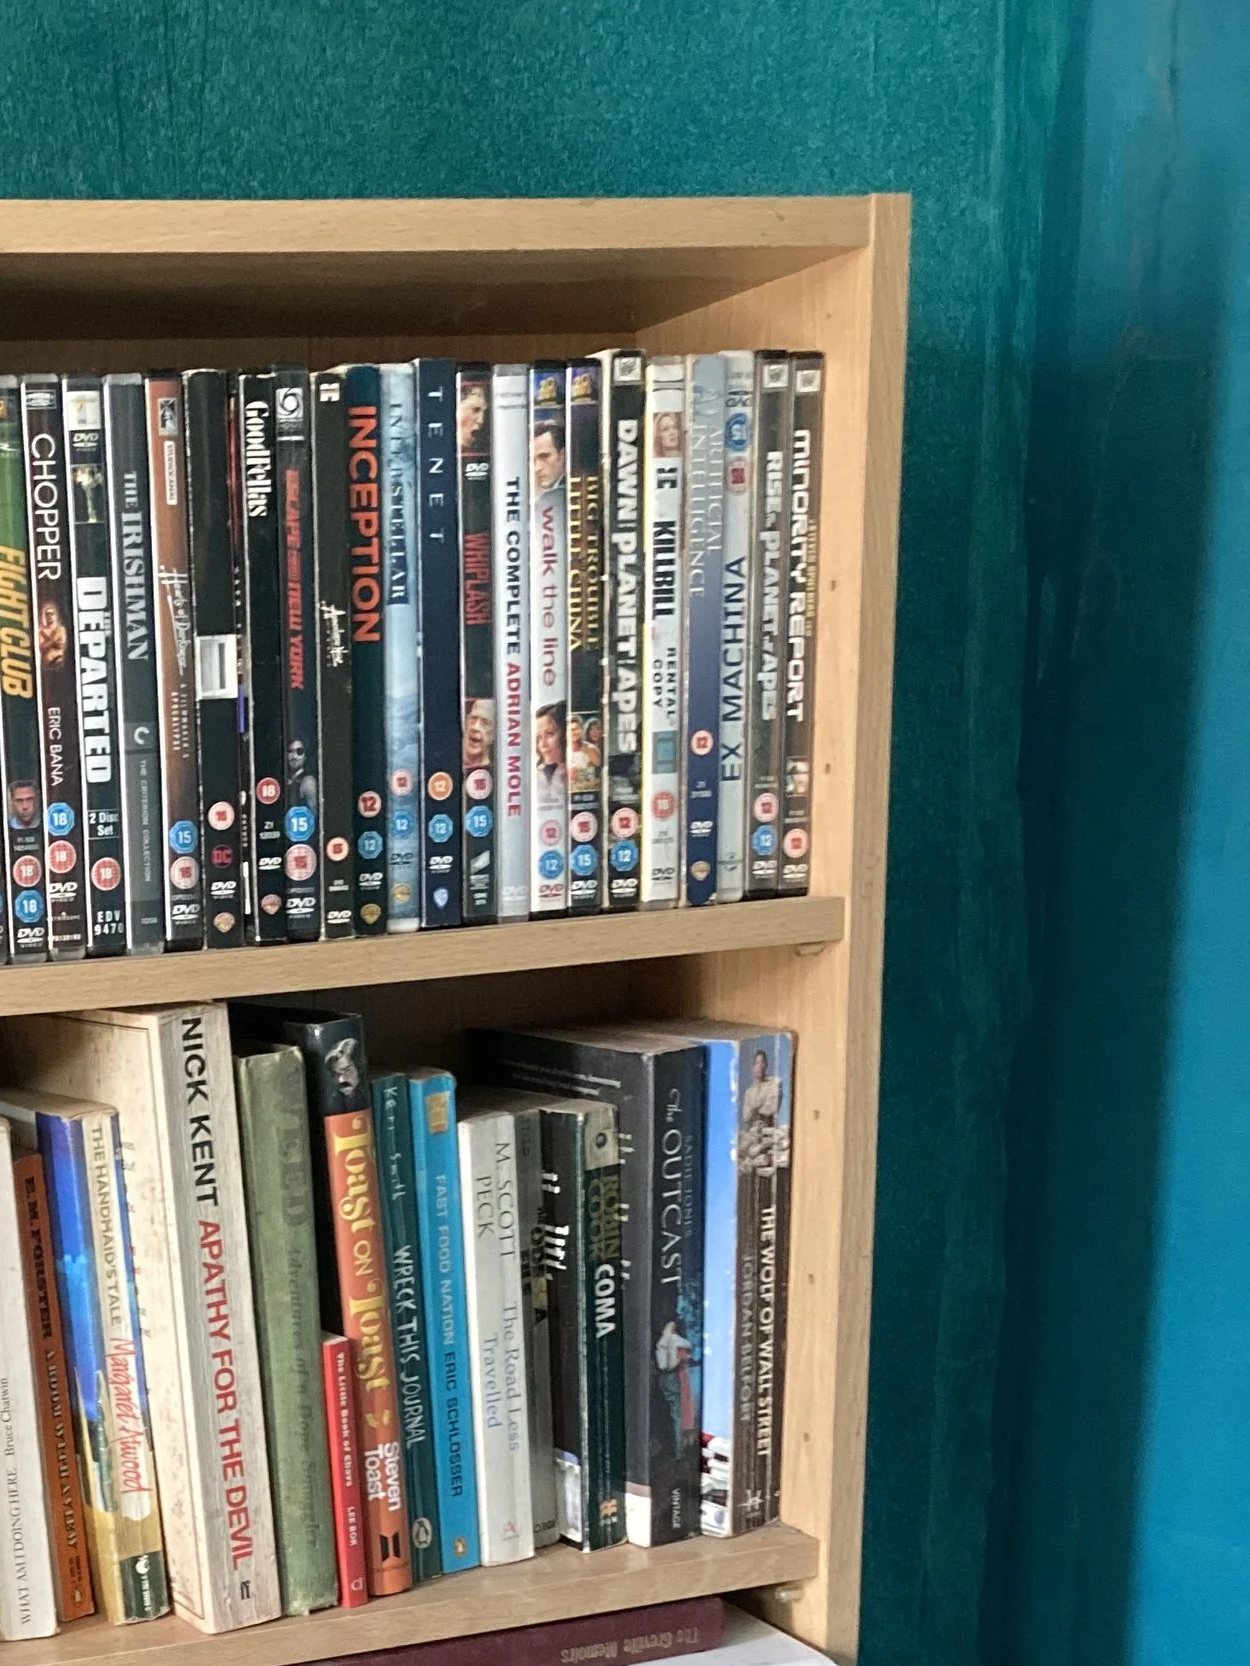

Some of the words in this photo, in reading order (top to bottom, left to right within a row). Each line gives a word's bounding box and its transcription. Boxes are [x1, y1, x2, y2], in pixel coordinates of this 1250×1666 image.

[123, 471, 138, 509] THE
[386, 402, 409, 600] INTERSTELLAR
[505, 475, 521, 525] THE
[616, 418, 639, 523] DAWN
[31, 432, 62, 580] CHOPPER
[347, 403, 382, 643] INCEPTION
[541, 505, 560, 576] walk
[121, 512, 150, 663] IRISHMAN
[463, 532, 492, 627] WHIPLASH
[505, 530, 523, 657] COMPLETE
[0, 625, 33, 699] CLUB
[76, 576, 113, 783] DEPARTED
[542, 635, 559, 688] line
[652, 658, 664, 709] COPY
[666, 646, 678, 725] RENTAL
[47, 706, 61, 743] ERIC
[506, 662, 523, 749] ADRIAN
[611, 670, 638, 753] APES
[49, 744, 66, 786] BANA
[506, 754, 523, 818] MOLE
[181, 1016, 210, 1105] NICK
[188, 1113, 219, 1207] KENT
[434, 1173, 449, 1217] FAST
[659, 1128, 684, 1285] OUTCAST
[198, 1219, 232, 1342] APATHY
[436, 1226, 451, 1273] FOOD
[107, 1279, 123, 1327] TALE
[440, 1279, 455, 1346] NATION
[501, 1303, 518, 1340] The
[594, 1263, 616, 1339] COMA
[0, 1377, 13, 1423] Chatwin
[211, 1349, 239, 1415] FOR
[443, 1351, 457, 1391] ERIC
[503, 1347, 521, 1401] Road
[757, 1338, 775, 1395] WALL
[2, 1423, 16, 1456] Bruce
[218, 1418, 246, 1482] THE
[363, 1443, 385, 1501] Toast
[381, 1441, 401, 1511] Steven
[225, 1484, 255, 1572] DEVIL
[16, 1583, 32, 1625] WHAT
